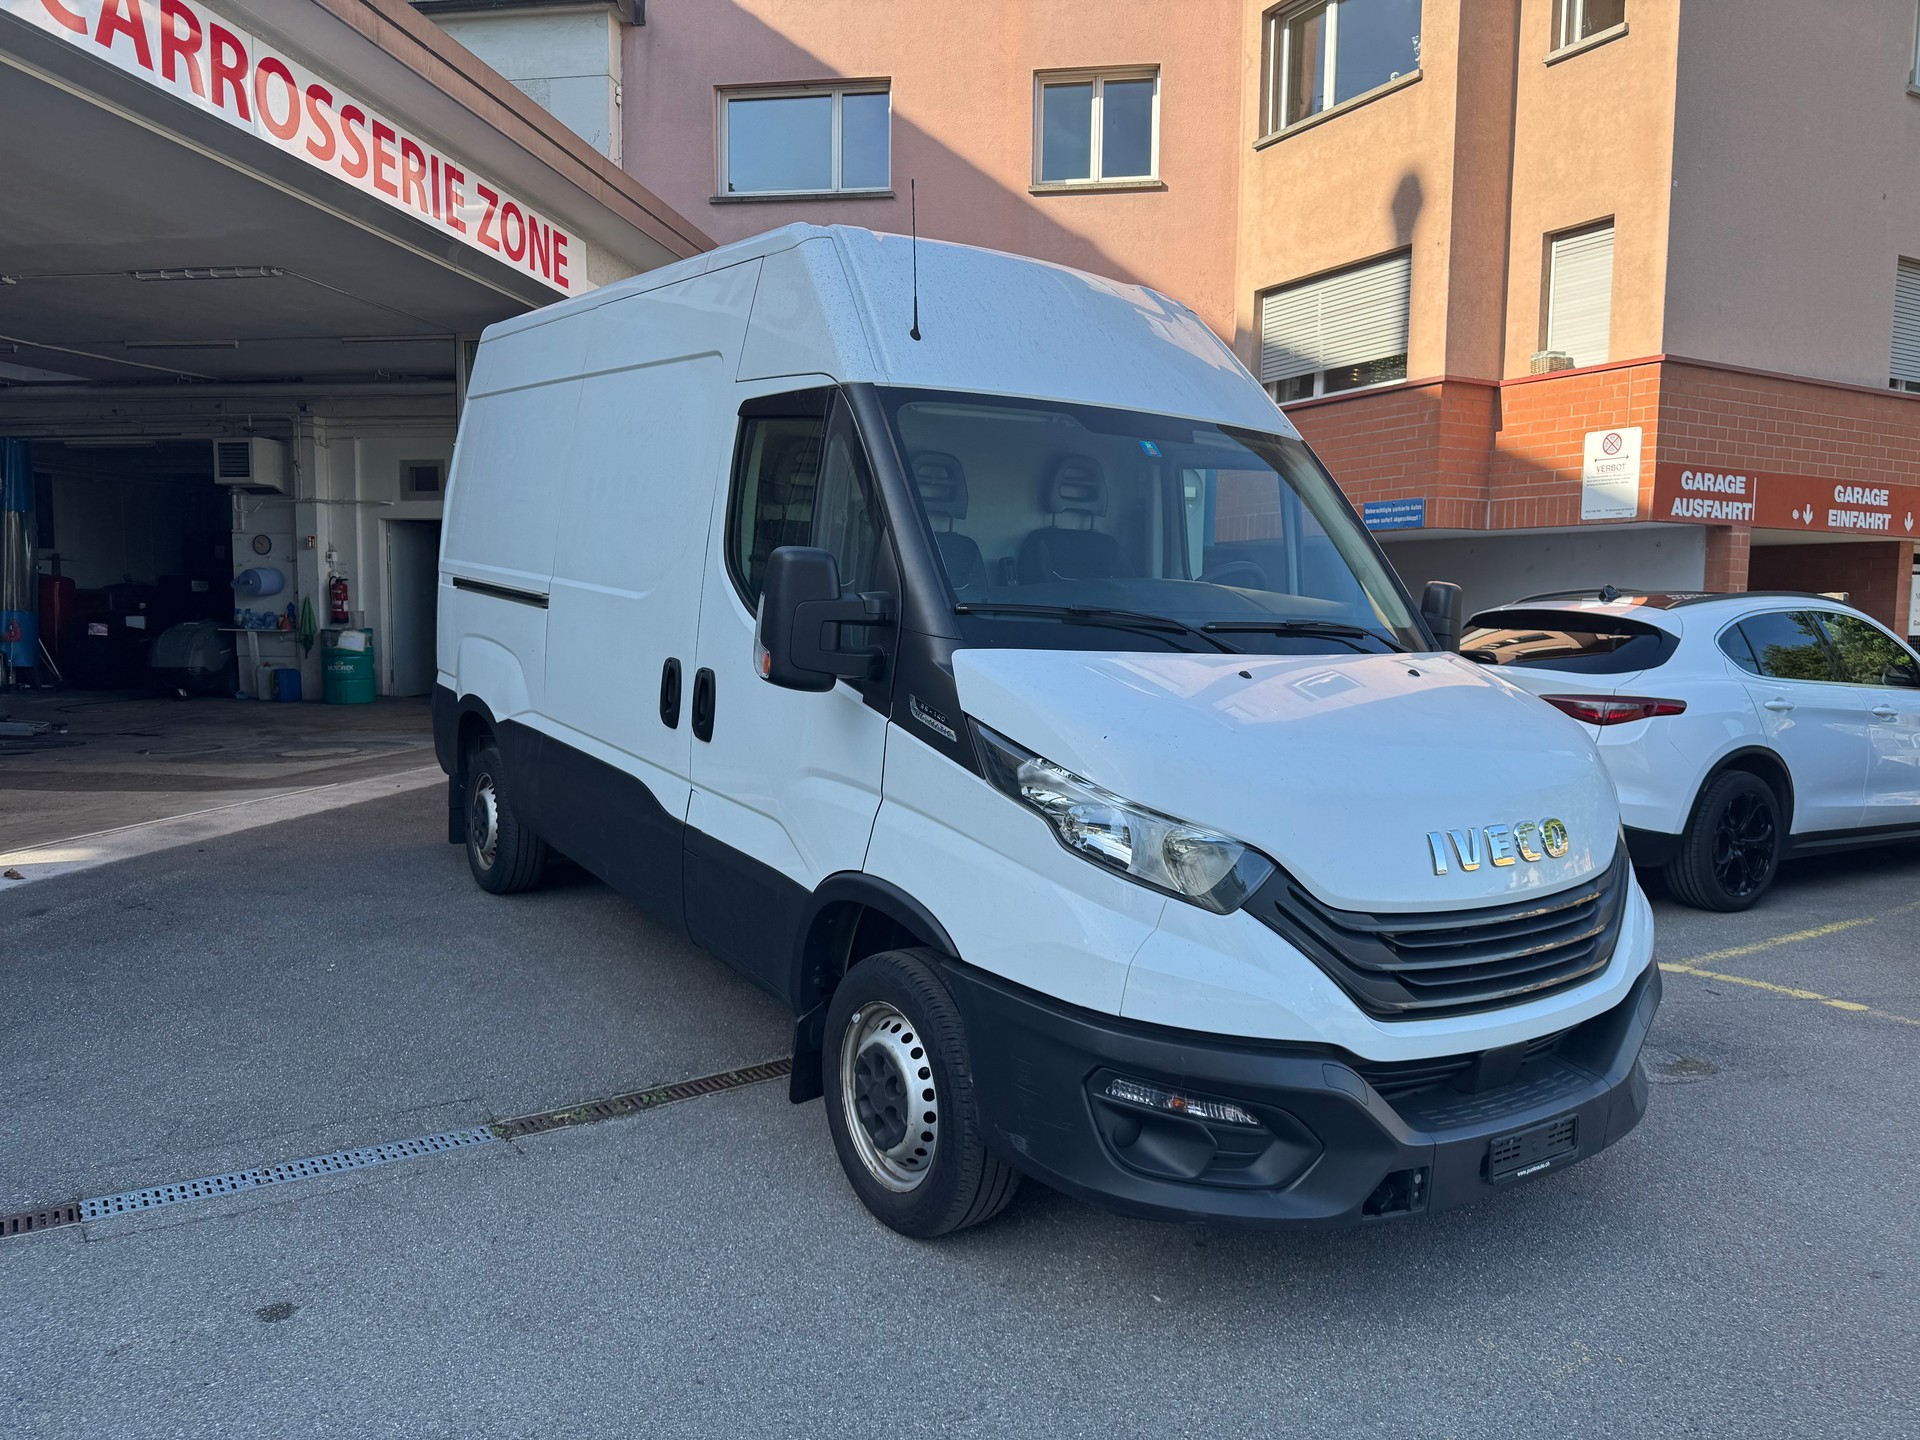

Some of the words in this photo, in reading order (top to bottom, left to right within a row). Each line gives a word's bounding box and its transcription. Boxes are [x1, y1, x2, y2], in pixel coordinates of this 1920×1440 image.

[476, 183, 570, 289] ZONE
[1596, 463, 1626, 473] VERBOT
[1681, 470, 1746, 494] GARAGE
[1834, 485, 1889, 506] GARAGE
[1671, 497, 1752, 521] AUSFAHRT
[1828, 509, 1891, 530] EINFAHRT
[1426, 817, 1569, 876] IVECO
